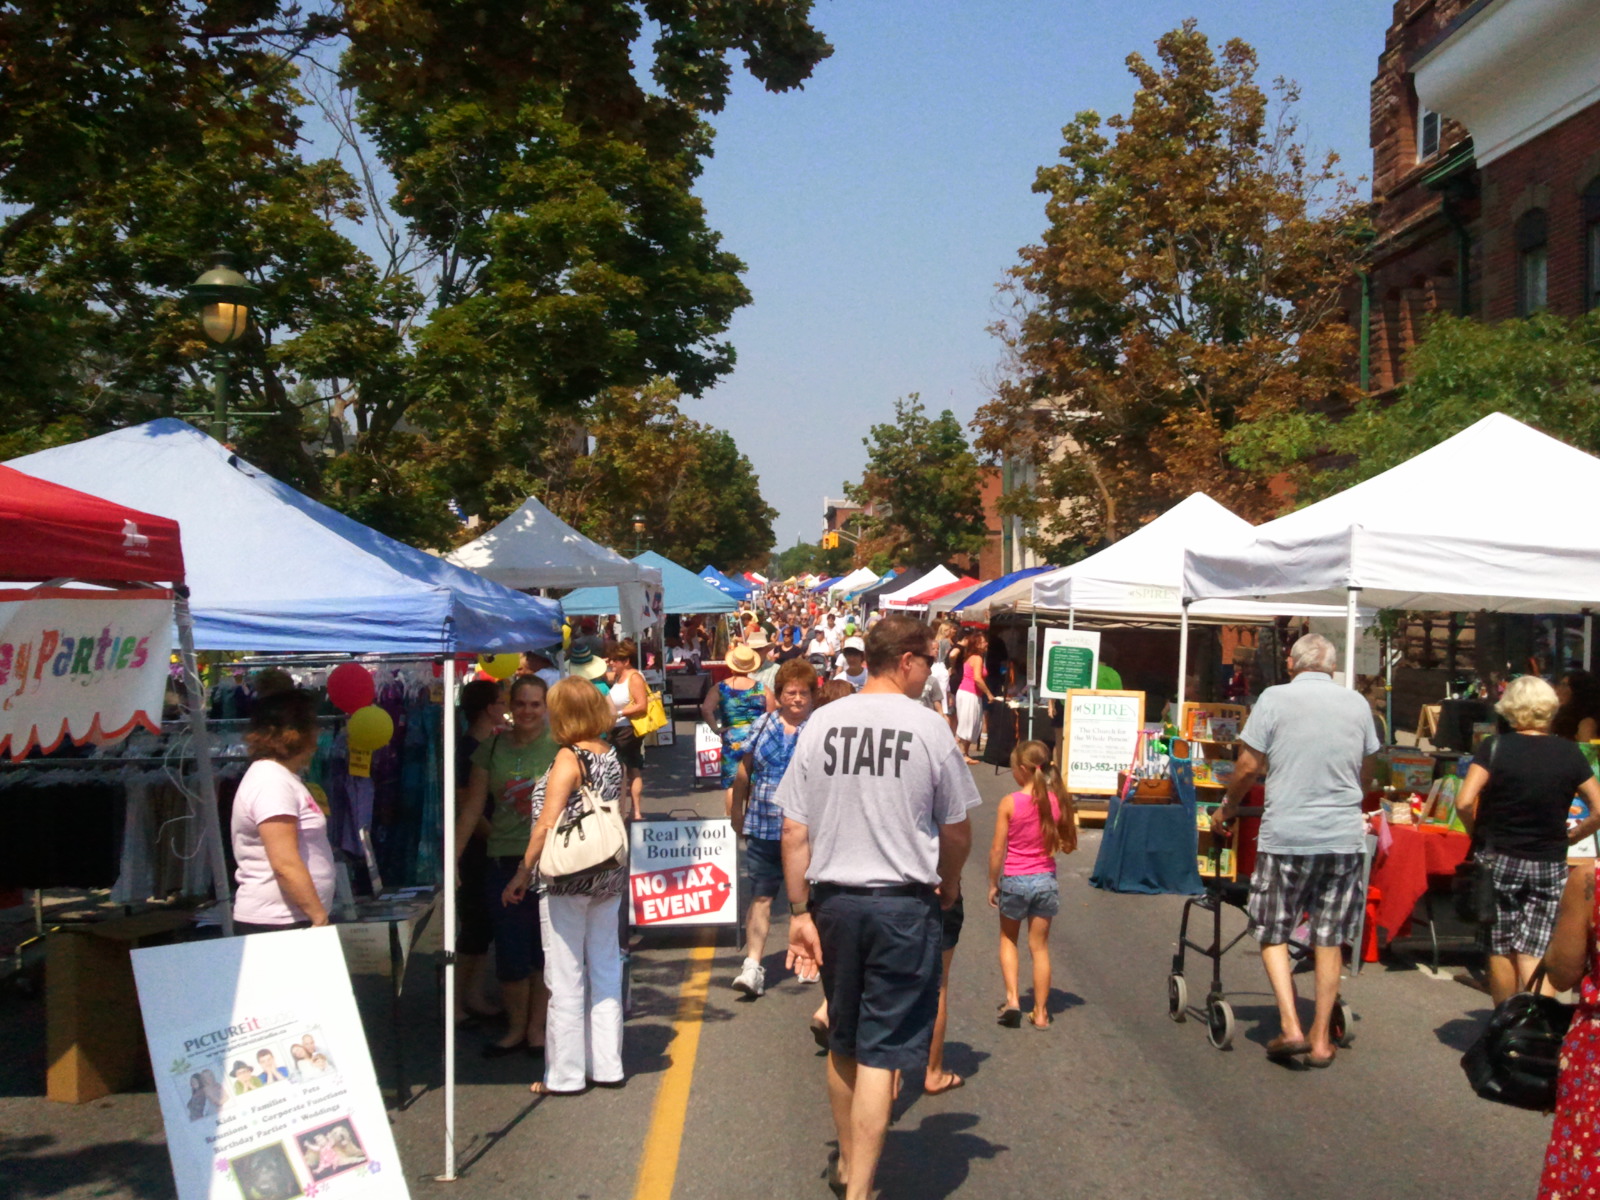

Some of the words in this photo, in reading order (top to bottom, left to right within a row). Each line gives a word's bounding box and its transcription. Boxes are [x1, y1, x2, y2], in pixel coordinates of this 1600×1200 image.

[33, 622, 152, 687] Parties
[1092, 727, 1116, 735] Church
[700, 749, 718, 762] NO
[824, 726, 913, 779] STAFF
[642, 826, 679, 842] Real
[684, 825, 727, 841] Wool
[647, 844, 723, 860] Boutique
[635, 874, 667, 897] NO
[673, 865, 715, 891] TAX
[643, 890, 714, 921] EVENT
[205, 1124, 248, 1145] Reunions
[261, 1103, 305, 1123] Corporate
[306, 1088, 348, 1107] Functions
[215, 1114, 238, 1127] Kids
[250, 1096, 287, 1114] Families
[302, 1085, 321, 1096] Pets
[213, 1135, 255, 1154] Birthday
[256, 1122, 287, 1138] Parties
[300, 1103, 341, 1121] Weddings
